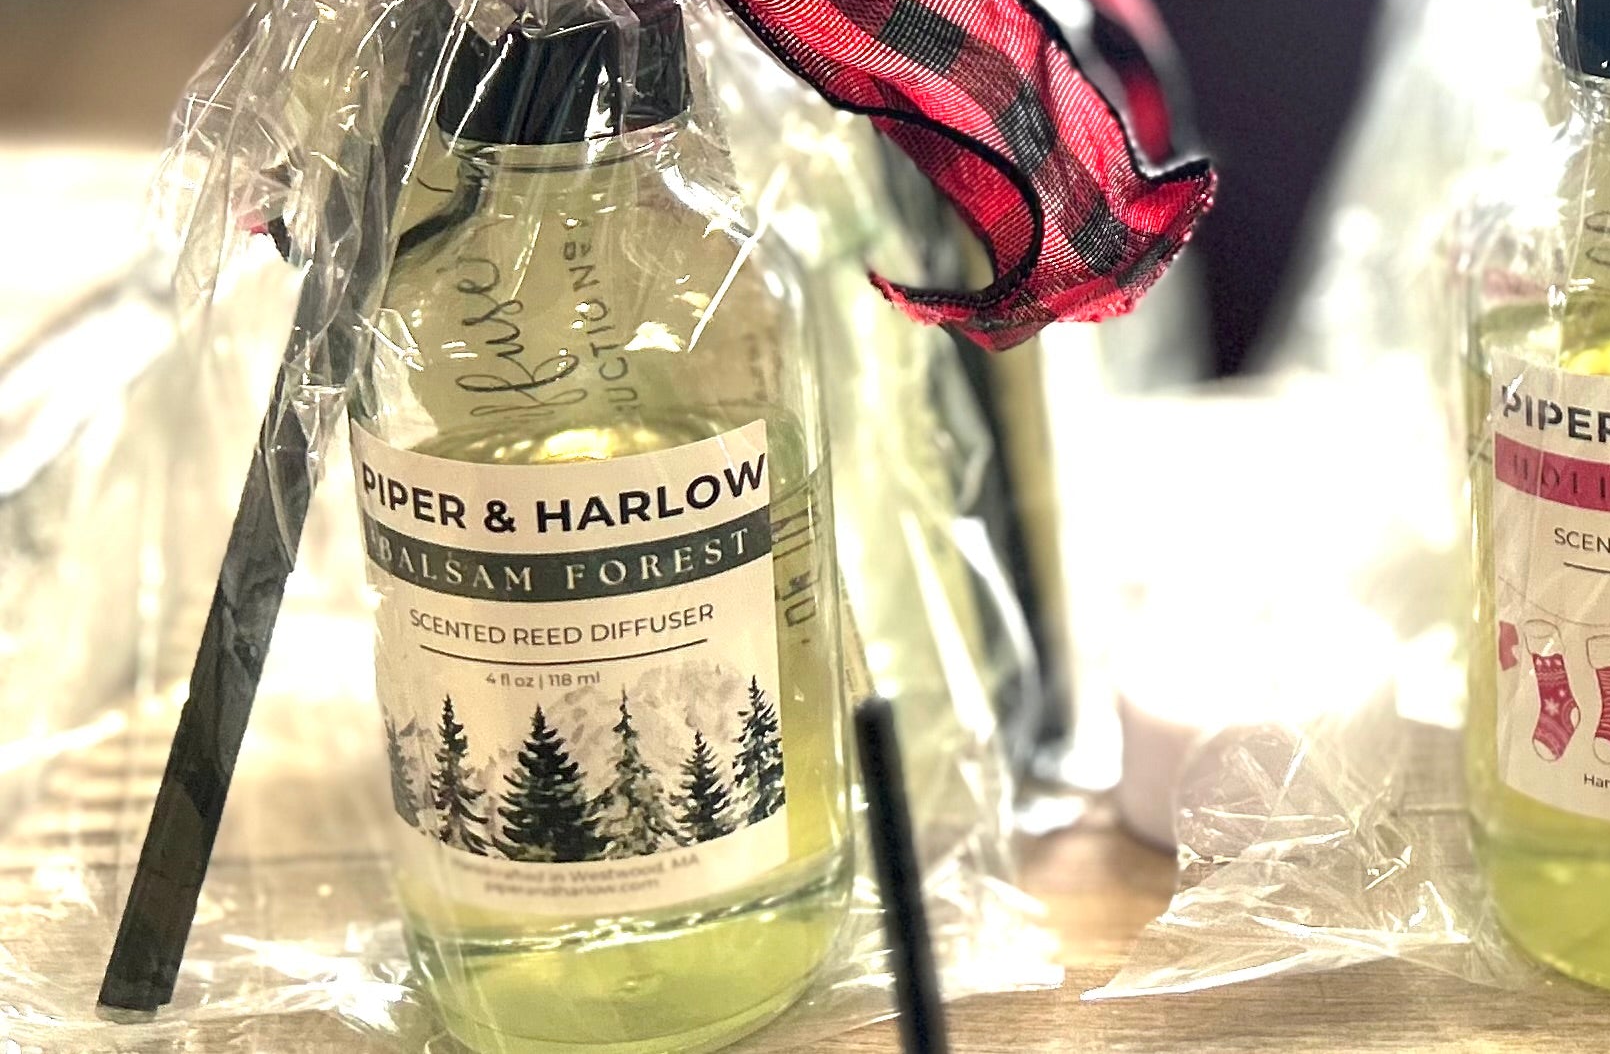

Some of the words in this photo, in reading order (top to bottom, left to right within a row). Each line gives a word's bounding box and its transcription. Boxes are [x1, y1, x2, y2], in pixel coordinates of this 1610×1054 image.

[362, 461, 467, 530] PIPER
[483, 498, 517, 534] &
[536, 452, 766, 534] HARLOW
[378, 534, 533, 593] BALSAM
[565, 526, 750, 591] FOREST
[408, 607, 506, 645] SCENTED
[512, 626, 583, 646] REED
[590, 602, 716, 643] DIFFUSER
[485, 672, 497, 685] 4
[501, 672, 511, 686] fl
[514, 676, 535, 688] oz
[548, 672, 573, 687] 118
[577, 670, 601, 685] ml
